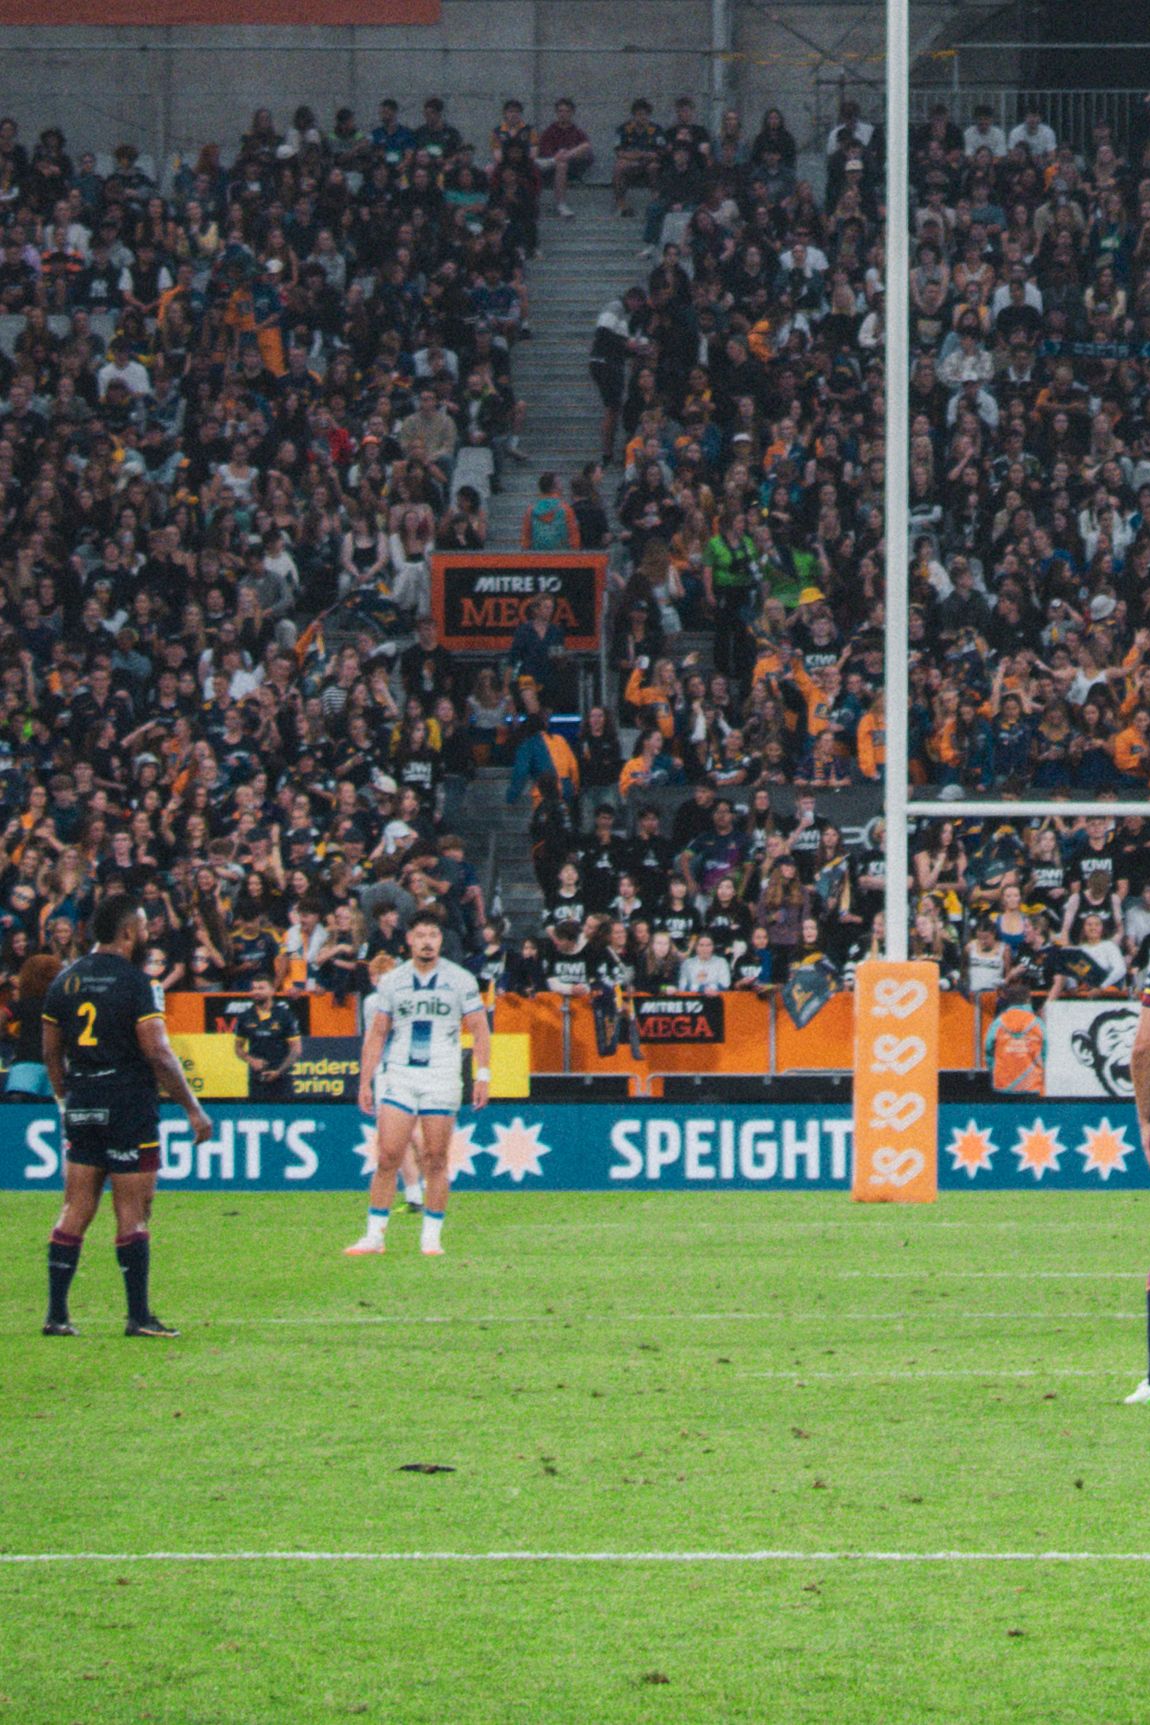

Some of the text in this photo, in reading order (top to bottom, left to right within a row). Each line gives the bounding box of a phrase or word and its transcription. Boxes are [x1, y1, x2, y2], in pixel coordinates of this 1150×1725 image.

[474, 576, 562, 592] MITRE 10
[416, 997, 452, 1016] nib
[77, 1002, 98, 1046] 2
[637, 1017, 714, 1038] MEGA
[291, 1059, 359, 1075] anders
[24, 1119, 319, 1179] SGHT'S
[609, 1119, 854, 1180] SPEIGHT
